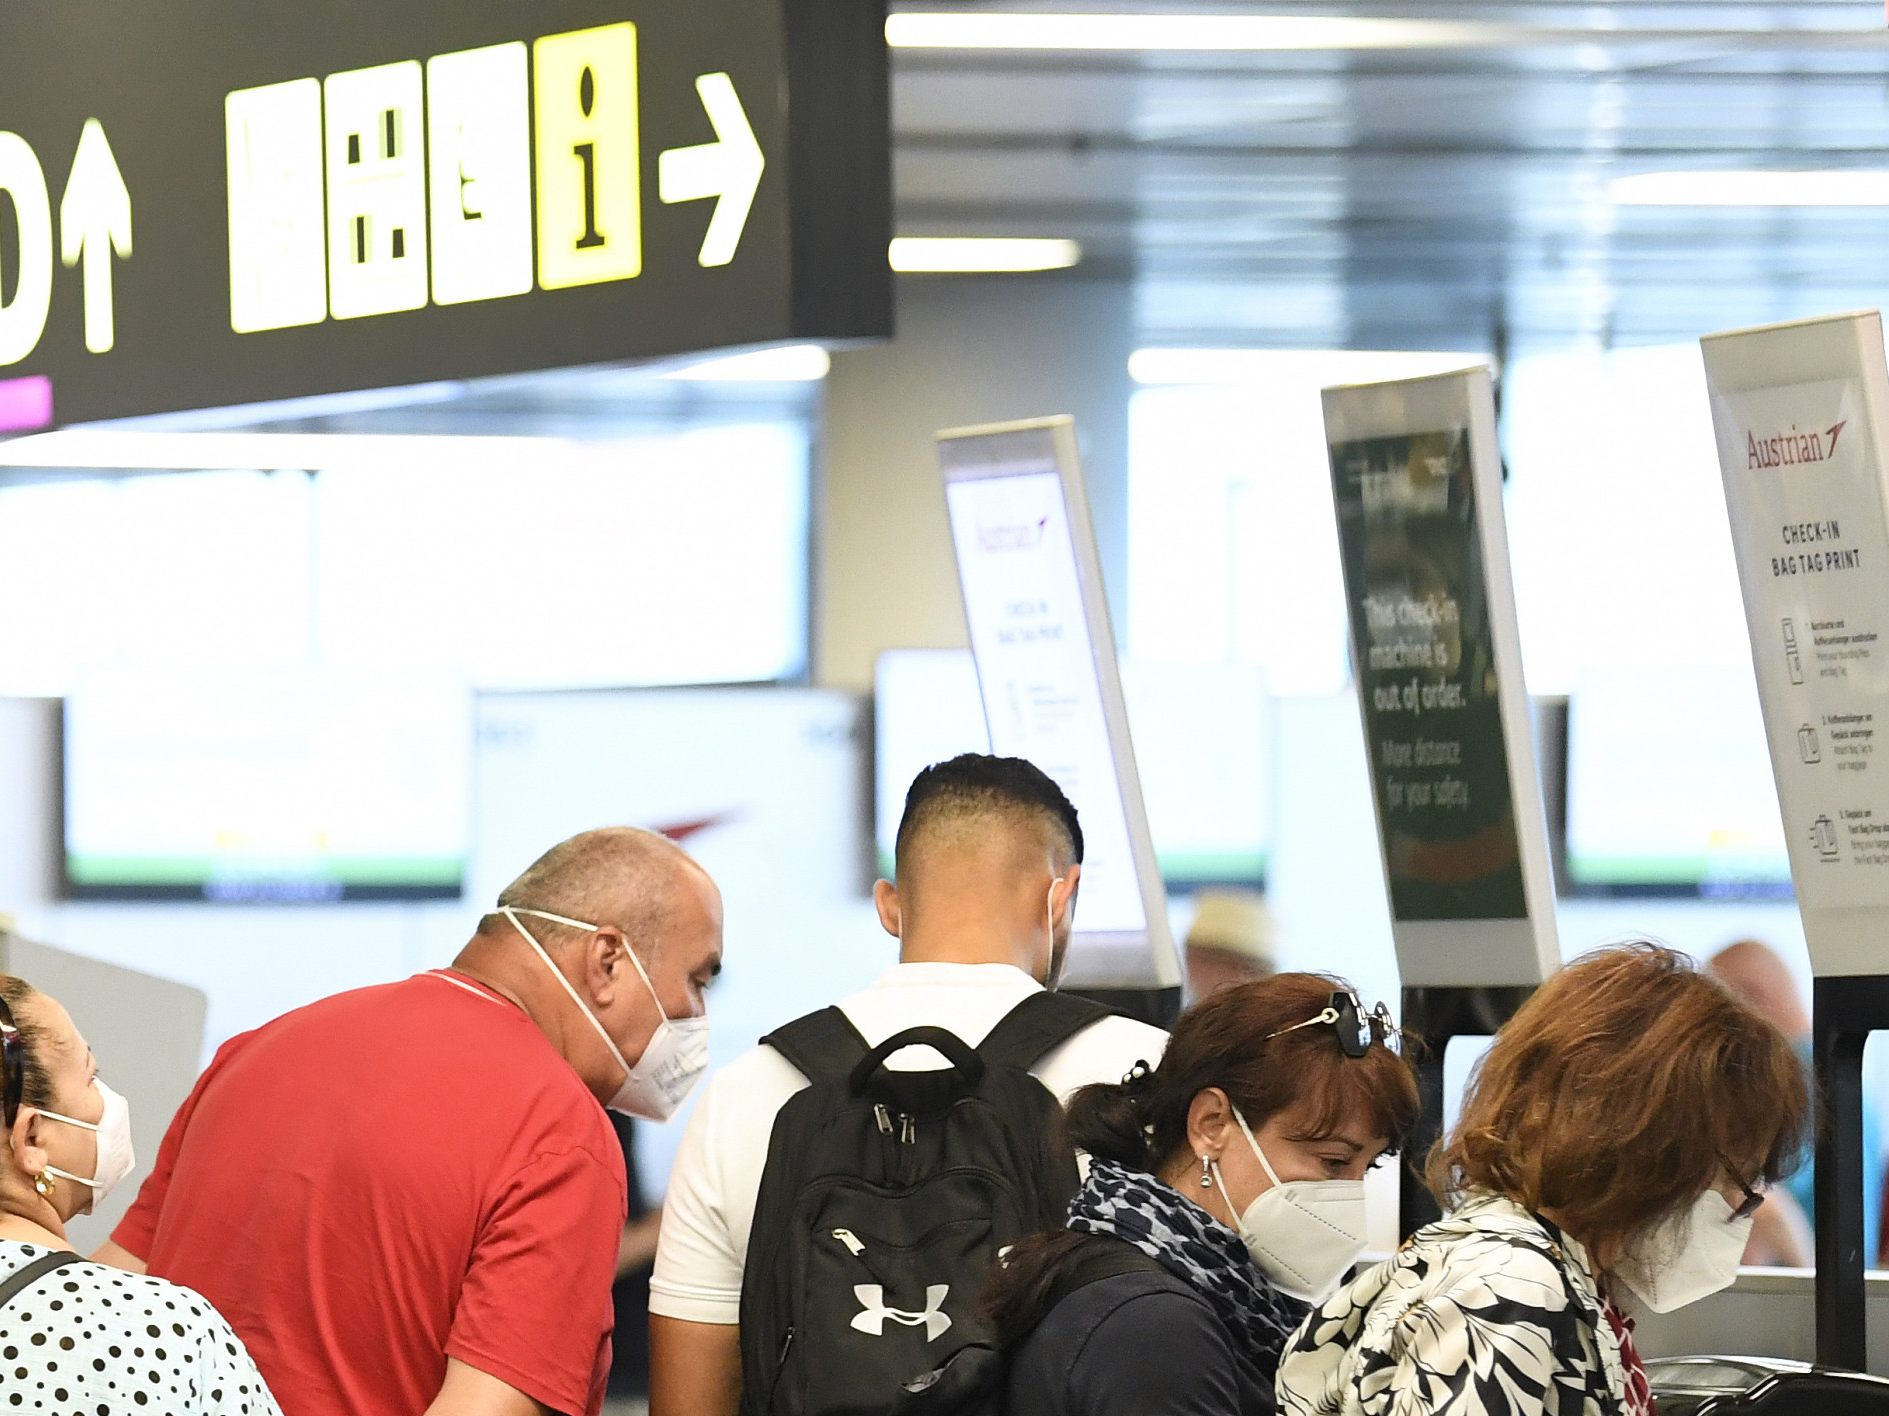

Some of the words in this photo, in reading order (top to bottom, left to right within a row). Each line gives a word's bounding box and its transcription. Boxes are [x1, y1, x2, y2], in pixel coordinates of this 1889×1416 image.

[1748, 424, 1823, 469] Austrian
[1782, 520, 1841, 545] CHECK-IN
[1771, 556, 1797, 577] BAG
[1799, 553, 1824, 574] TAG
[1825, 549, 1860, 571] PRINT
[1373, 684, 1401, 711] out
[1402, 677, 1420, 717] of
[1421, 675, 1466, 710] order.
